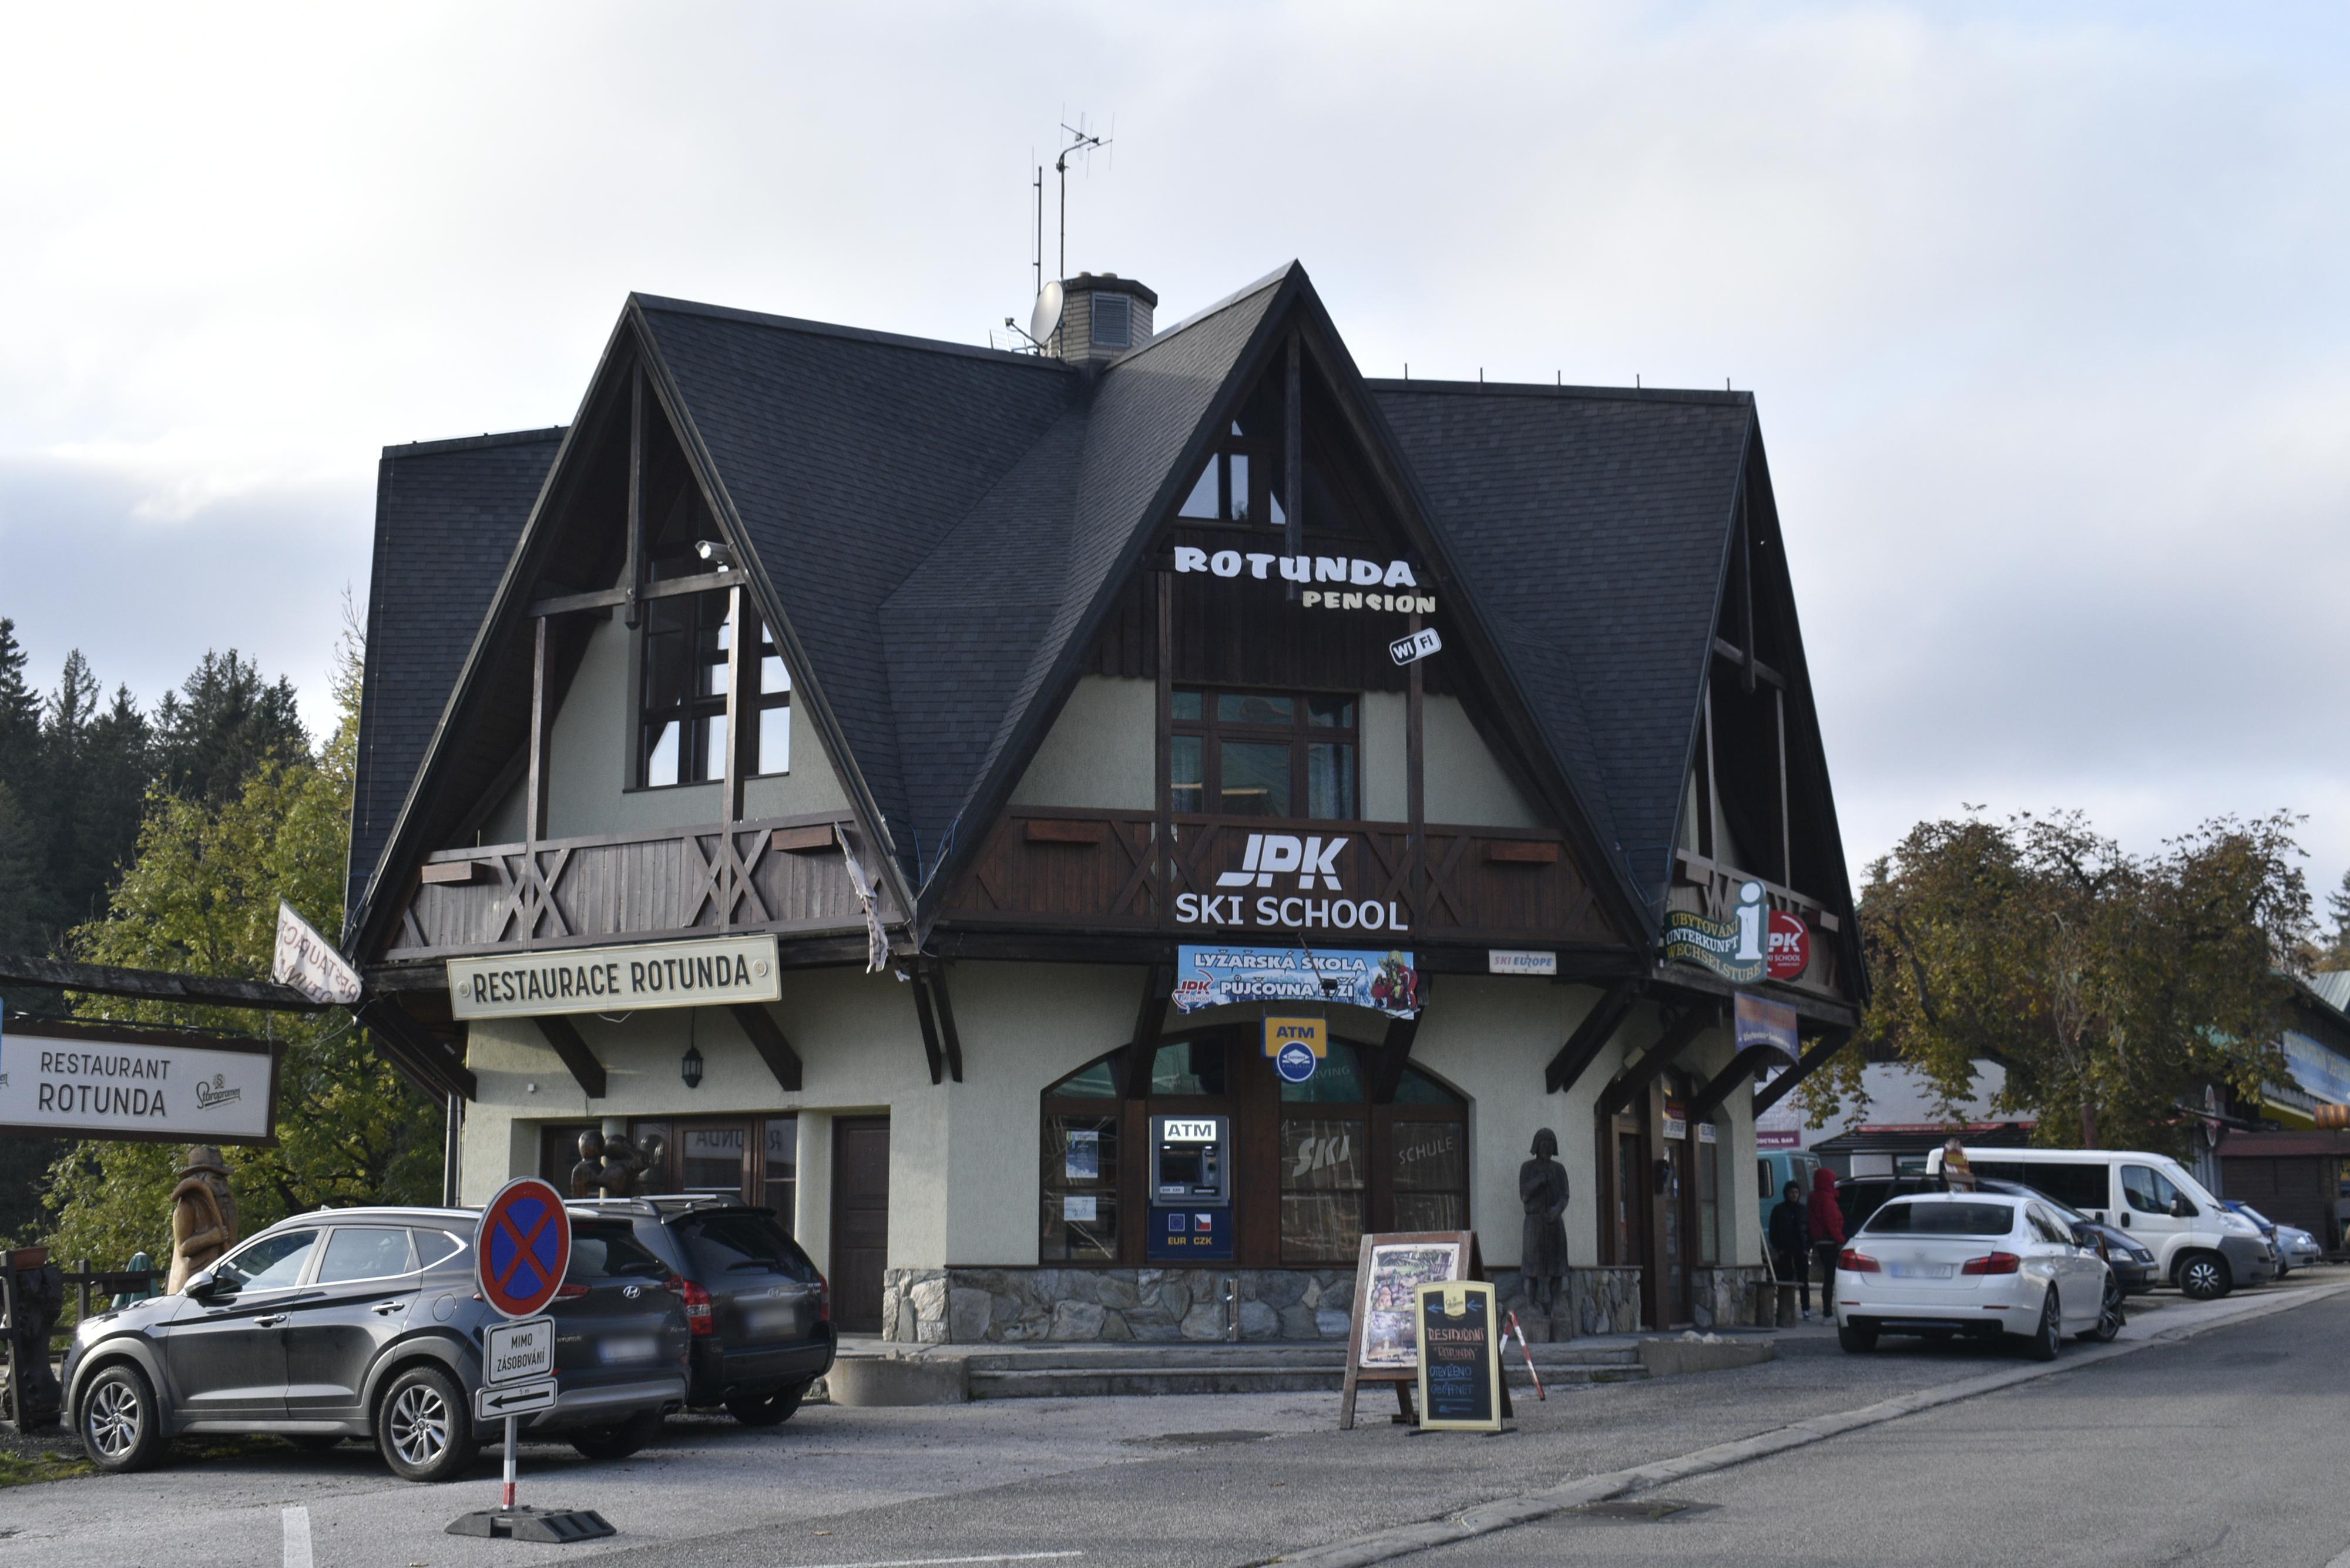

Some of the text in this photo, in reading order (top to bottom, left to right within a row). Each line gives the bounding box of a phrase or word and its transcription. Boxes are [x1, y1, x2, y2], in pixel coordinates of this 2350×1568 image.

[1175, 546, 1416, 587] ROTUNDA
[1302, 591, 1436, 614] PENSION
[1216, 834, 1349, 891] JPK
[1176, 893, 1408, 931] SKI SCHOOL
[1671, 912, 1739, 938] UBYTOVÁNÍ
[1666, 928, 1739, 953] UNTERKUNFT
[1768, 932, 1801, 952] PK
[1194, 949, 1368, 971] LYŽAŘSKÁ ŠKOLA
[1494, 956, 1511, 965] SKI
[1667, 943, 1761, 982] WECHSELSTUBE
[473, 953, 751, 1003] RESTAURACE ROTUNDA
[1175, 981, 1211, 994] JPK
[1220, 975, 1315, 997] PŮJČOVNA
[1277, 1026, 1315, 1038] ATM
[41, 1052, 171, 1080] RESTAURANT
[39, 1083, 167, 1117] ROTUNDA
[196, 1081, 241, 1109] Staropramen
[1167, 1123, 1212, 1137] ATM
[1292, 1135, 1453, 1177] SKI SCHULE
[1168, 1237, 1212, 1245] EUR CZK
[511, 1333, 532, 1349] MIMO
[497, 1347, 545, 1372] ZÁSOBOVÁNÍ
